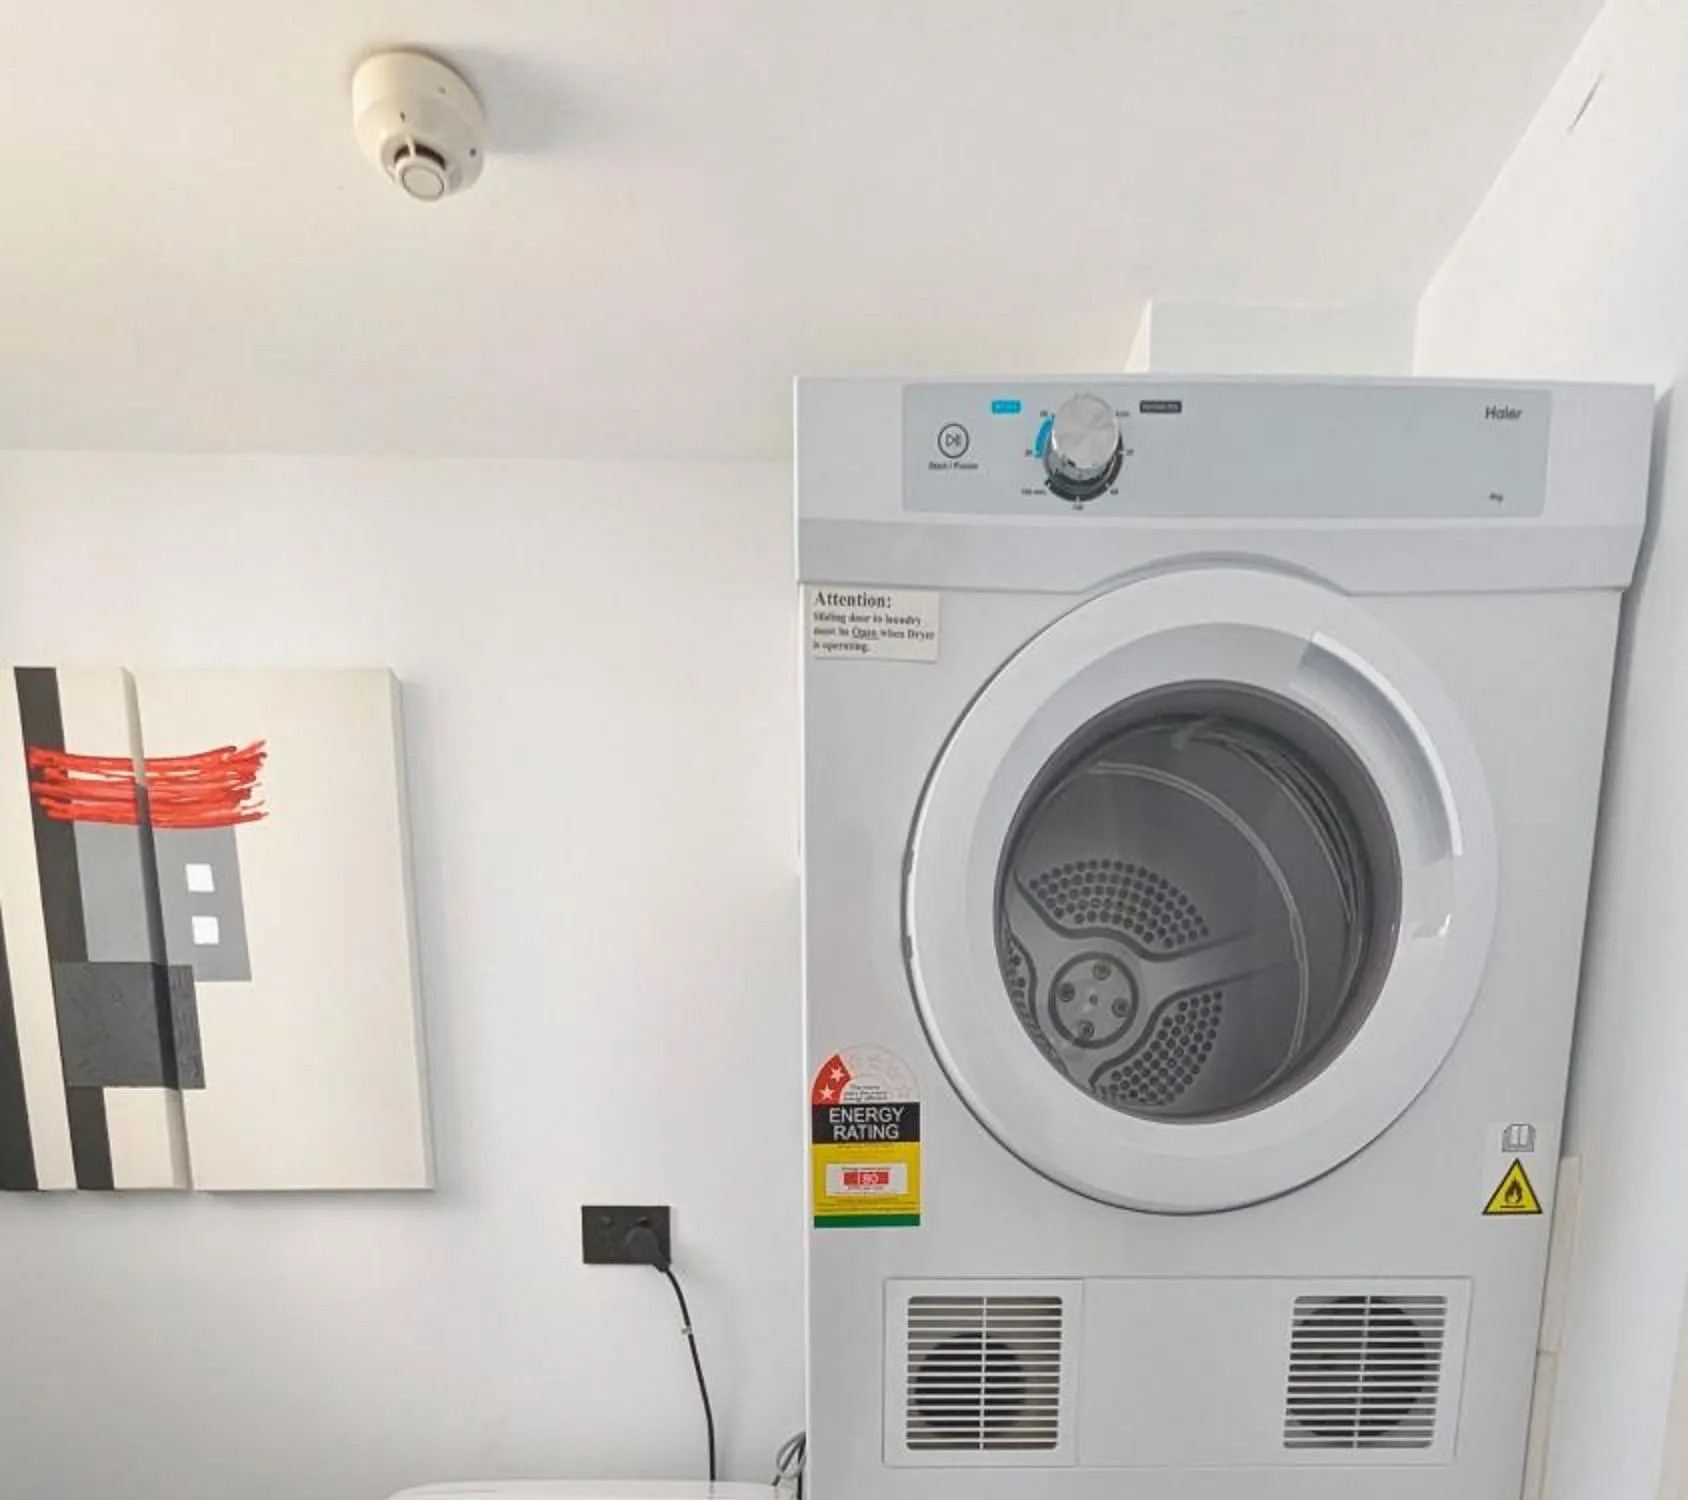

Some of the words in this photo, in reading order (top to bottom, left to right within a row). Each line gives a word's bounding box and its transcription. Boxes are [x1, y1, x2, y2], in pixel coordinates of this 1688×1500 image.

[1485, 405, 1522, 420] Haier
[814, 592, 892, 608] Attention:
[813, 612, 847, 624] Sliding
[850, 612, 871, 623] door
[885, 614, 922, 626] laundry
[813, 627, 837, 636] must
[839, 627, 849, 637] be
[852, 627, 878, 640] Open
[880, 628, 905, 639] when
[908, 629, 935, 643] Dryer
[829, 1106, 905, 1123] ENERGY
[833, 1123, 900, 1141] RATING
